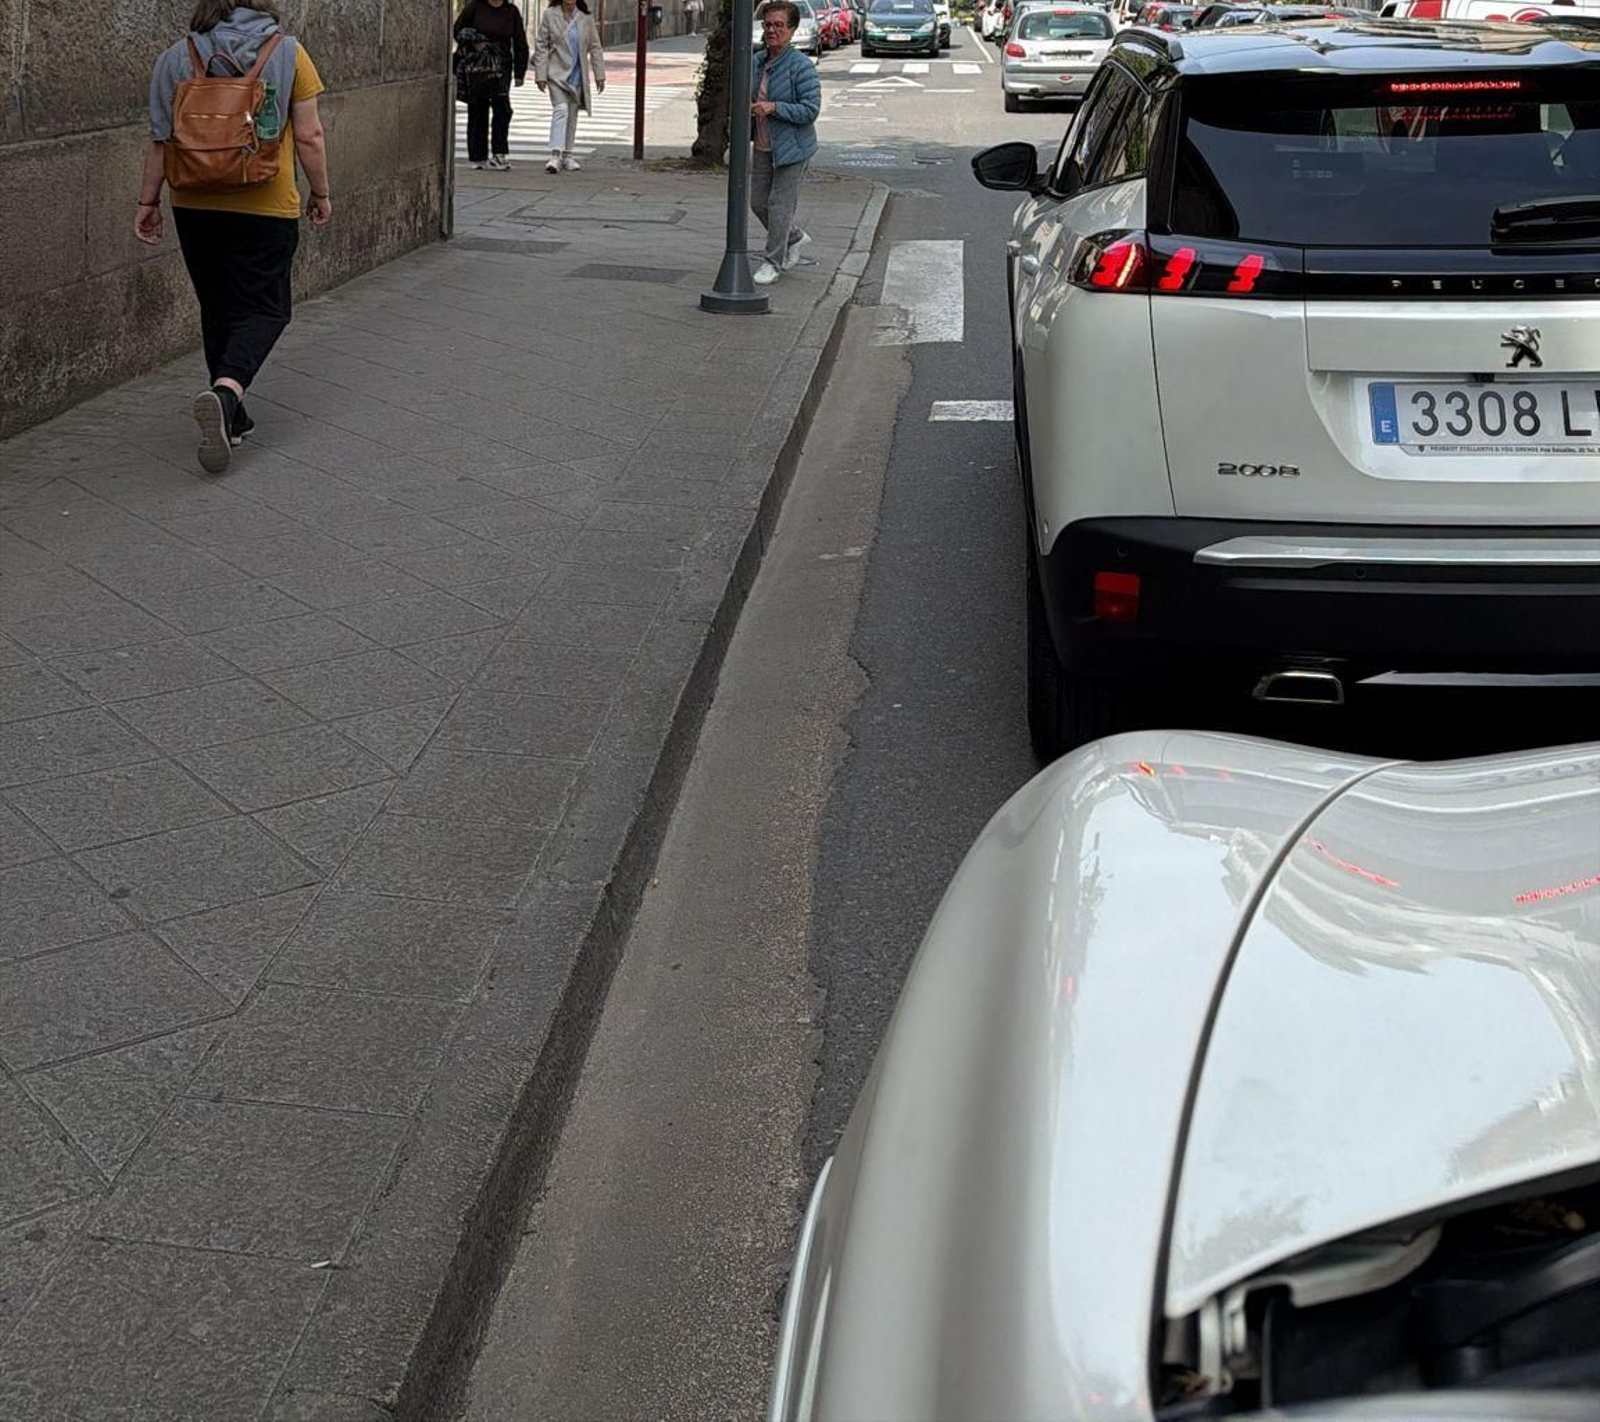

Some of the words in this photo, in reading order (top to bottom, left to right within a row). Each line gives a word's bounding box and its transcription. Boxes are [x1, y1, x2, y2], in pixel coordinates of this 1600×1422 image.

[1411, 390, 1541, 436] 3308
[1560, 389, 1600, 436] L
[1381, 420, 1391, 432] E
[1218, 463, 1300, 477] 2008
